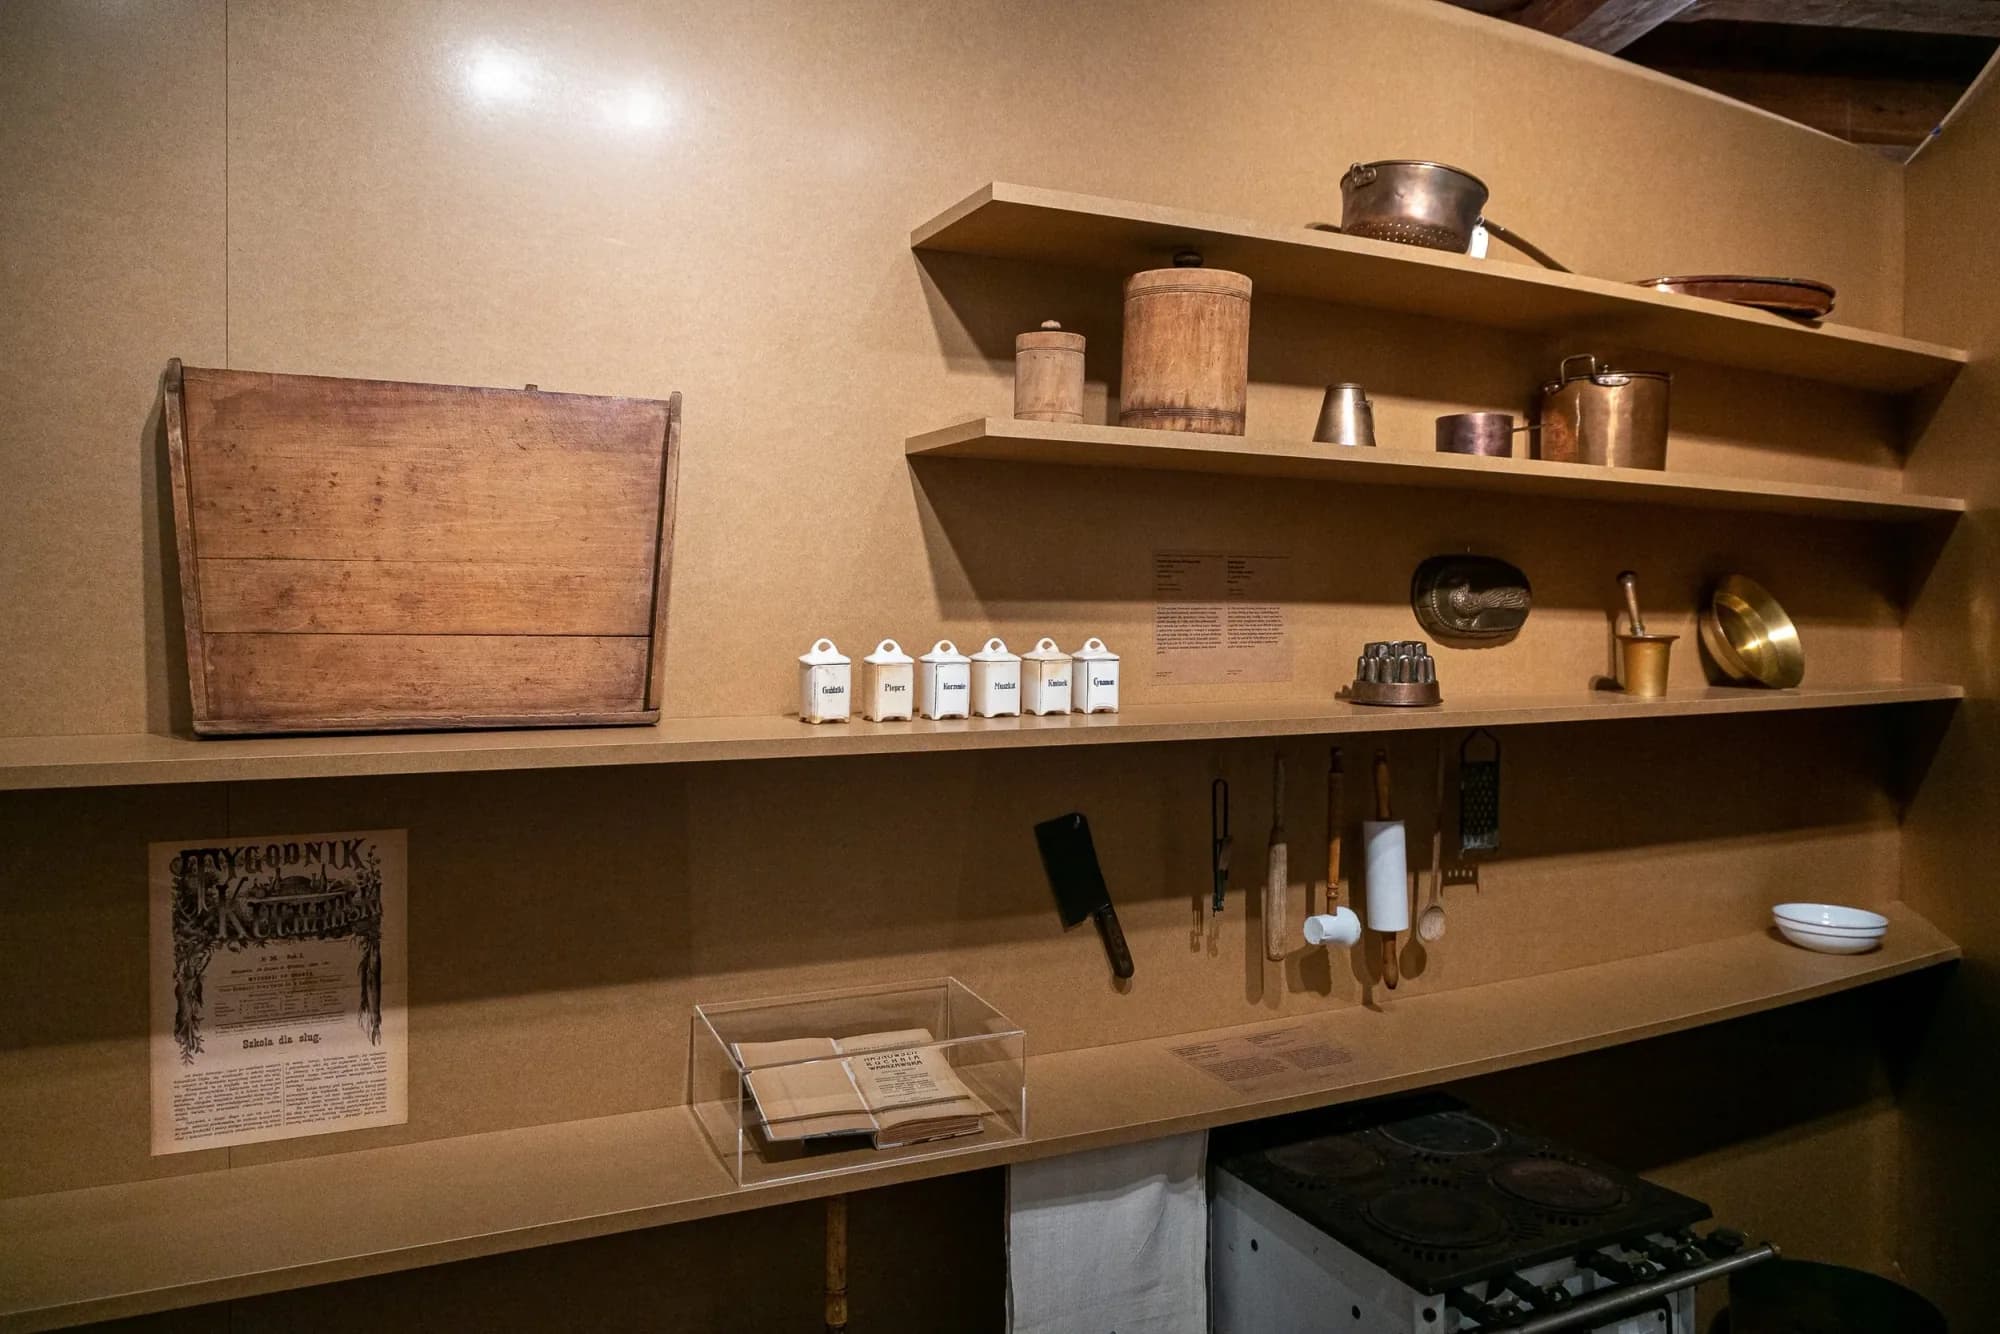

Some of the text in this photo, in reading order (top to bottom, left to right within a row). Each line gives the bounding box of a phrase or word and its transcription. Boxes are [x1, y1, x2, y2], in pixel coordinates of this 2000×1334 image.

[884, 683, 906, 693] Pieprz
[170, 838, 368, 912] TYGODNIK
[278, 1034, 293, 1045] dla
